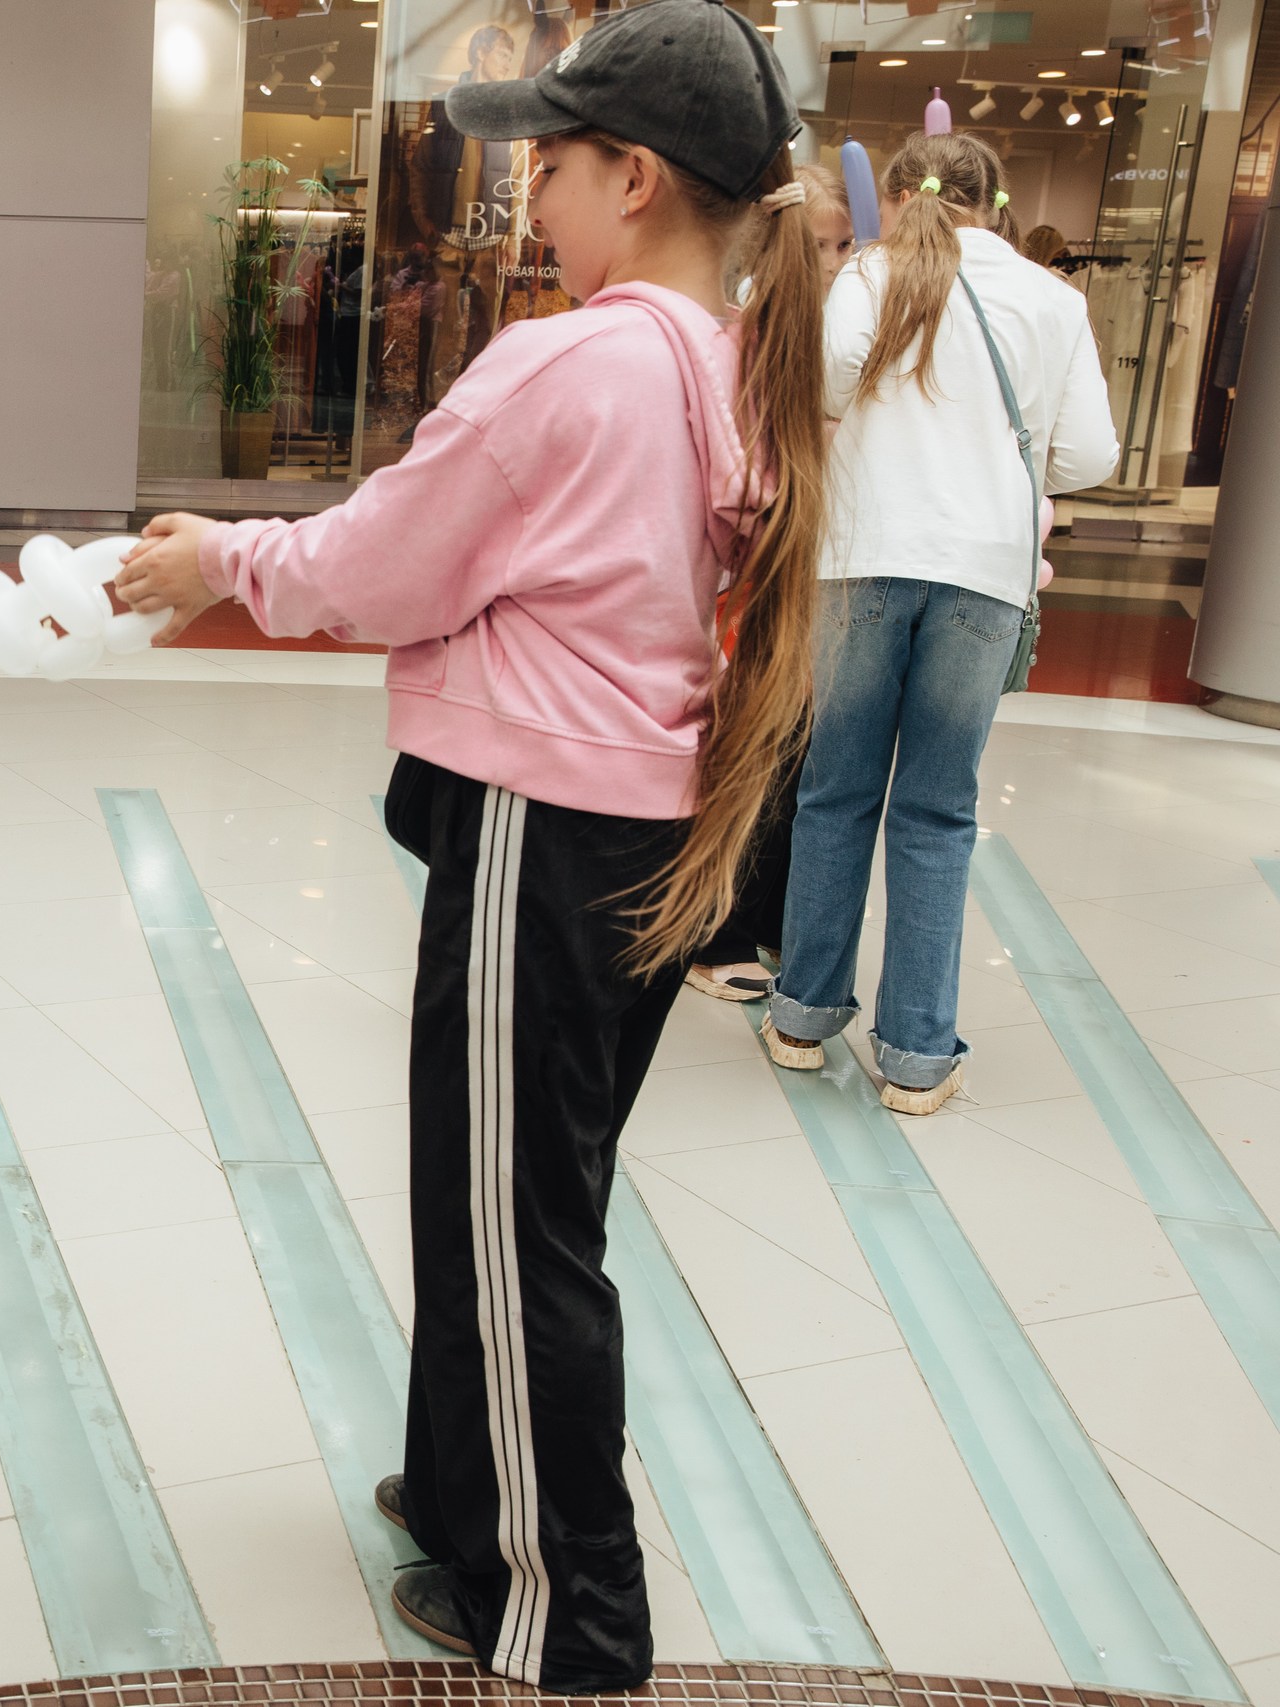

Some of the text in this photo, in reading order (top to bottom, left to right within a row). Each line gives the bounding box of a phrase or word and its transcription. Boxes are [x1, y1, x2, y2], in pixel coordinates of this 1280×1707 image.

[497, 264, 562, 278] НОВАЯ КОЛ
[1117, 357, 1138, 368] 119
